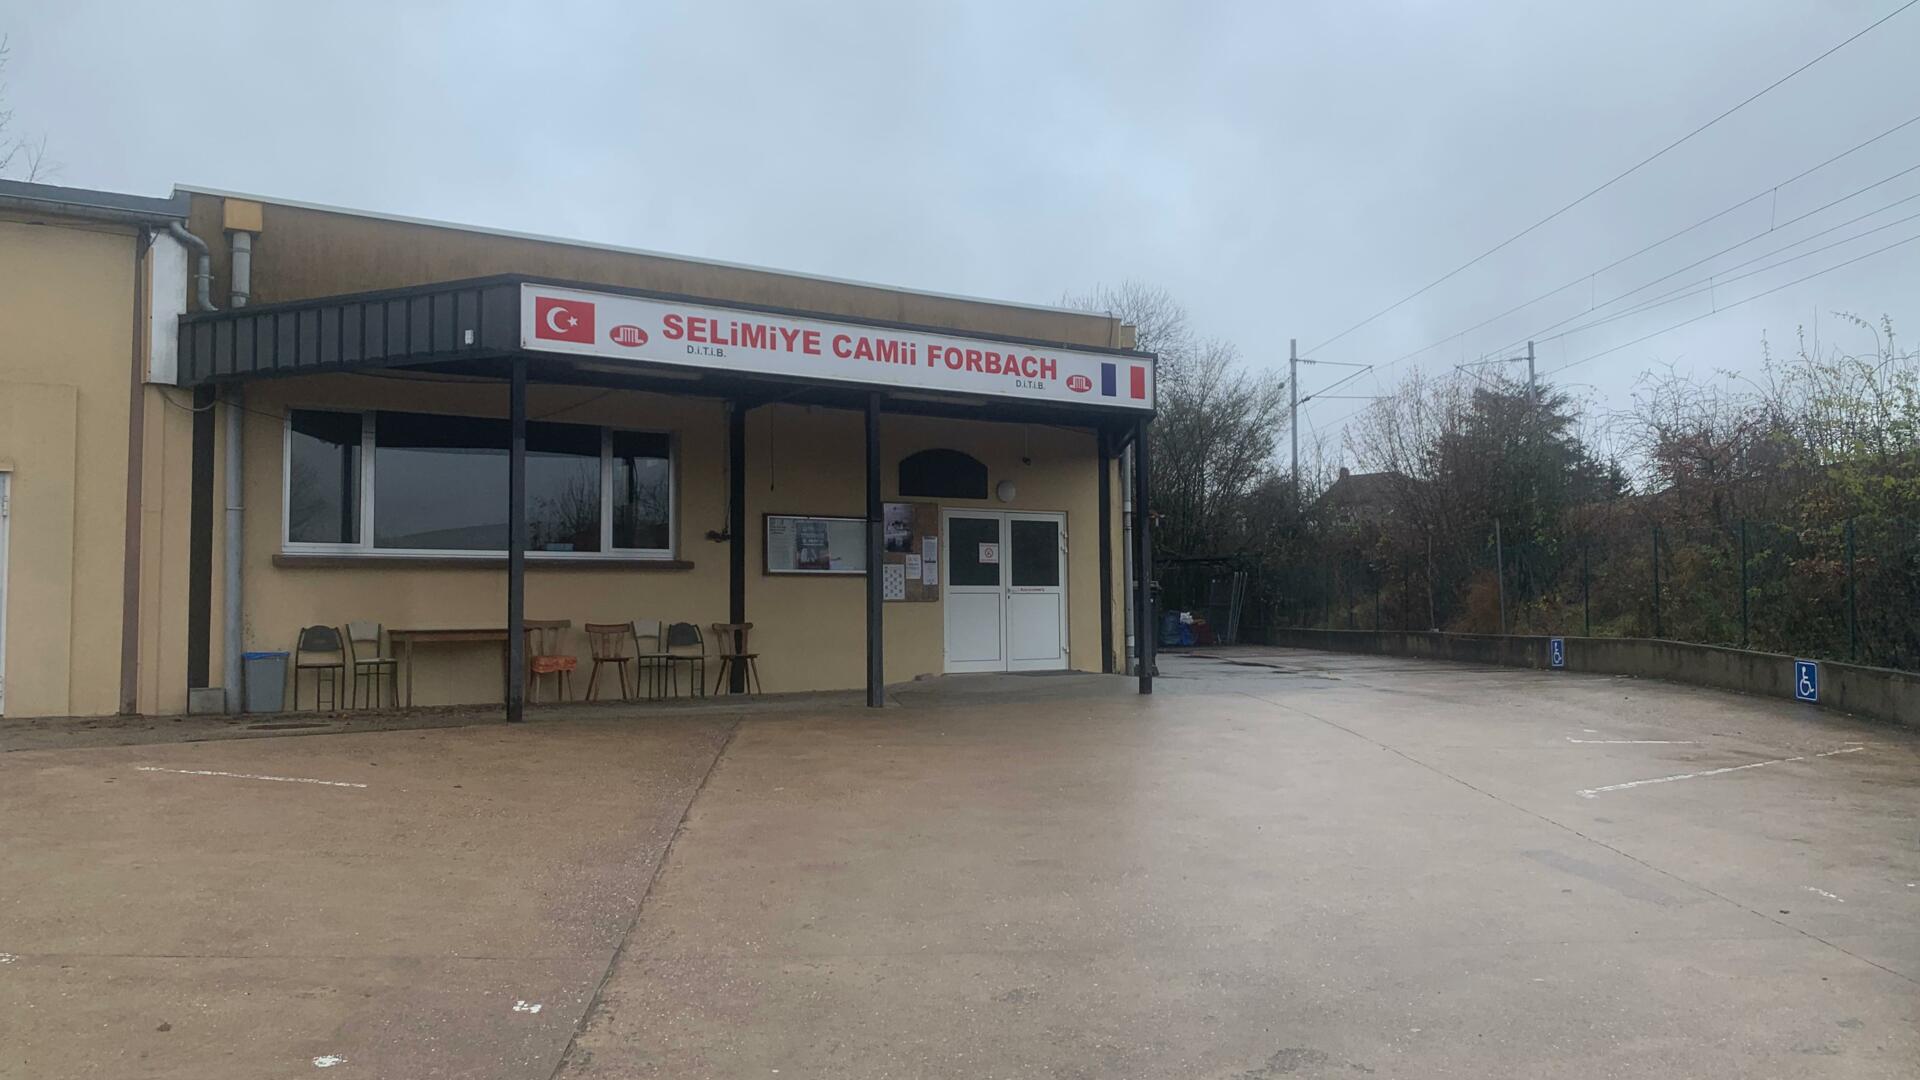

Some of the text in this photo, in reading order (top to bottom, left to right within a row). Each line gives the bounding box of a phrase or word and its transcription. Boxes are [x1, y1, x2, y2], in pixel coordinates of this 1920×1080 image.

[662, 313, 1057, 380] SELiMiYE CAMii FORBACH
